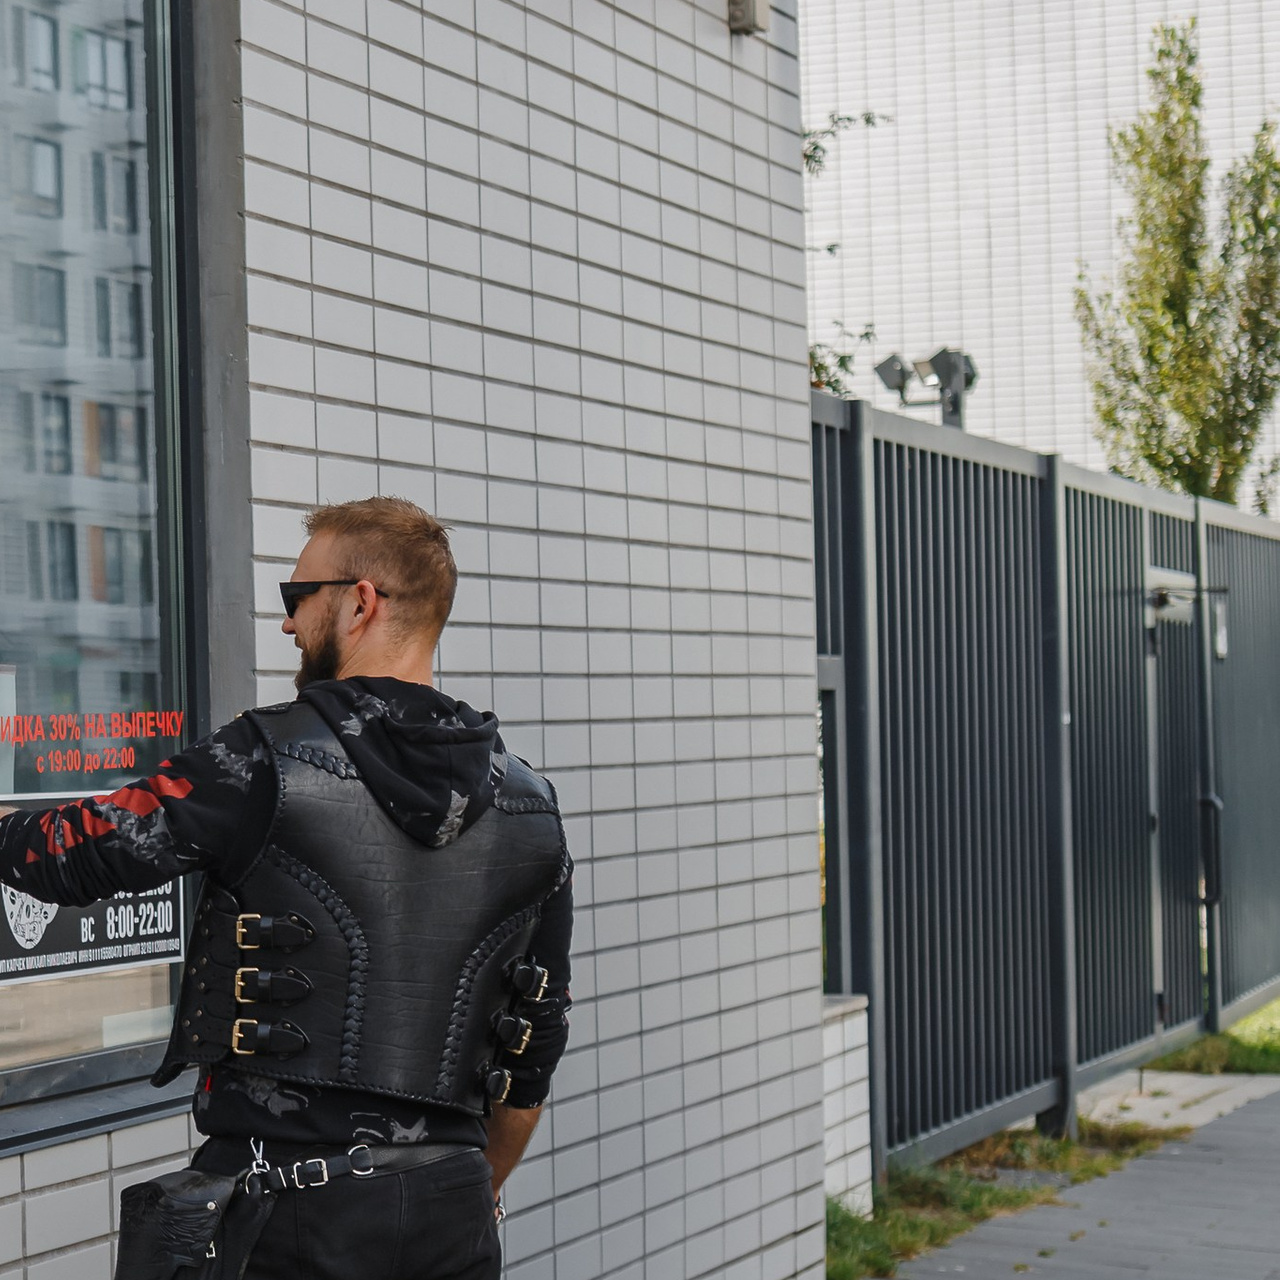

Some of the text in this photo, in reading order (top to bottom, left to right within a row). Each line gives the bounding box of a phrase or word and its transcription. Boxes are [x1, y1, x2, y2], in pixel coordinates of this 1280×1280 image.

[49, 713, 81, 741] 30%
[84, 713, 108, 740] НА
[110, 710, 184, 739] ВЫПЕЧКУ
[36, 746, 135, 774] с 19:00 до 22:00
[80, 900, 173, 943] ВС 8:00-22:00
